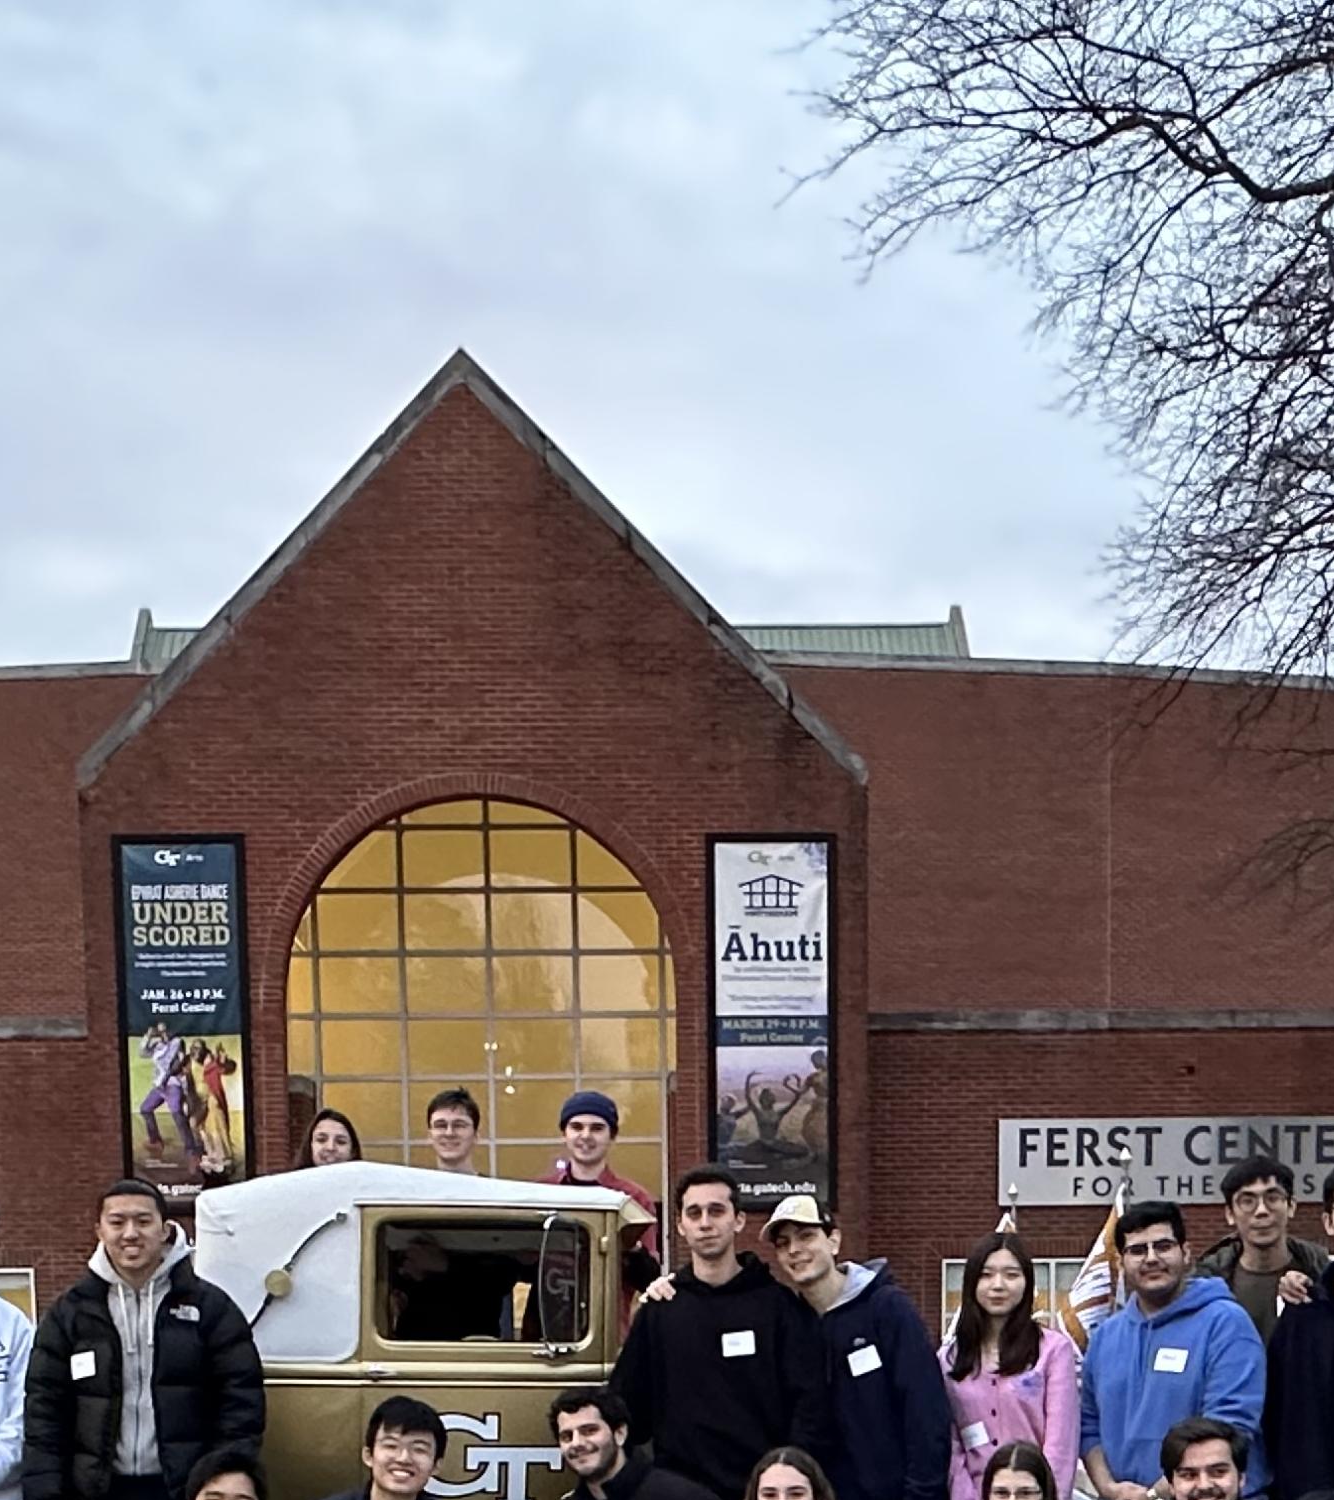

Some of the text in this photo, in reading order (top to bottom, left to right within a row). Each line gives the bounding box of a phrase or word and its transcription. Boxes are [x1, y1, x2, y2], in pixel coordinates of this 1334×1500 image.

[132, 901, 229, 924] UNDER
[132, 925, 230, 946] SCORED
[721, 925, 823, 962] Āhuti
[1018, 1127, 1163, 1168] FERST
[1156, 1175, 1215, 1197] THE
